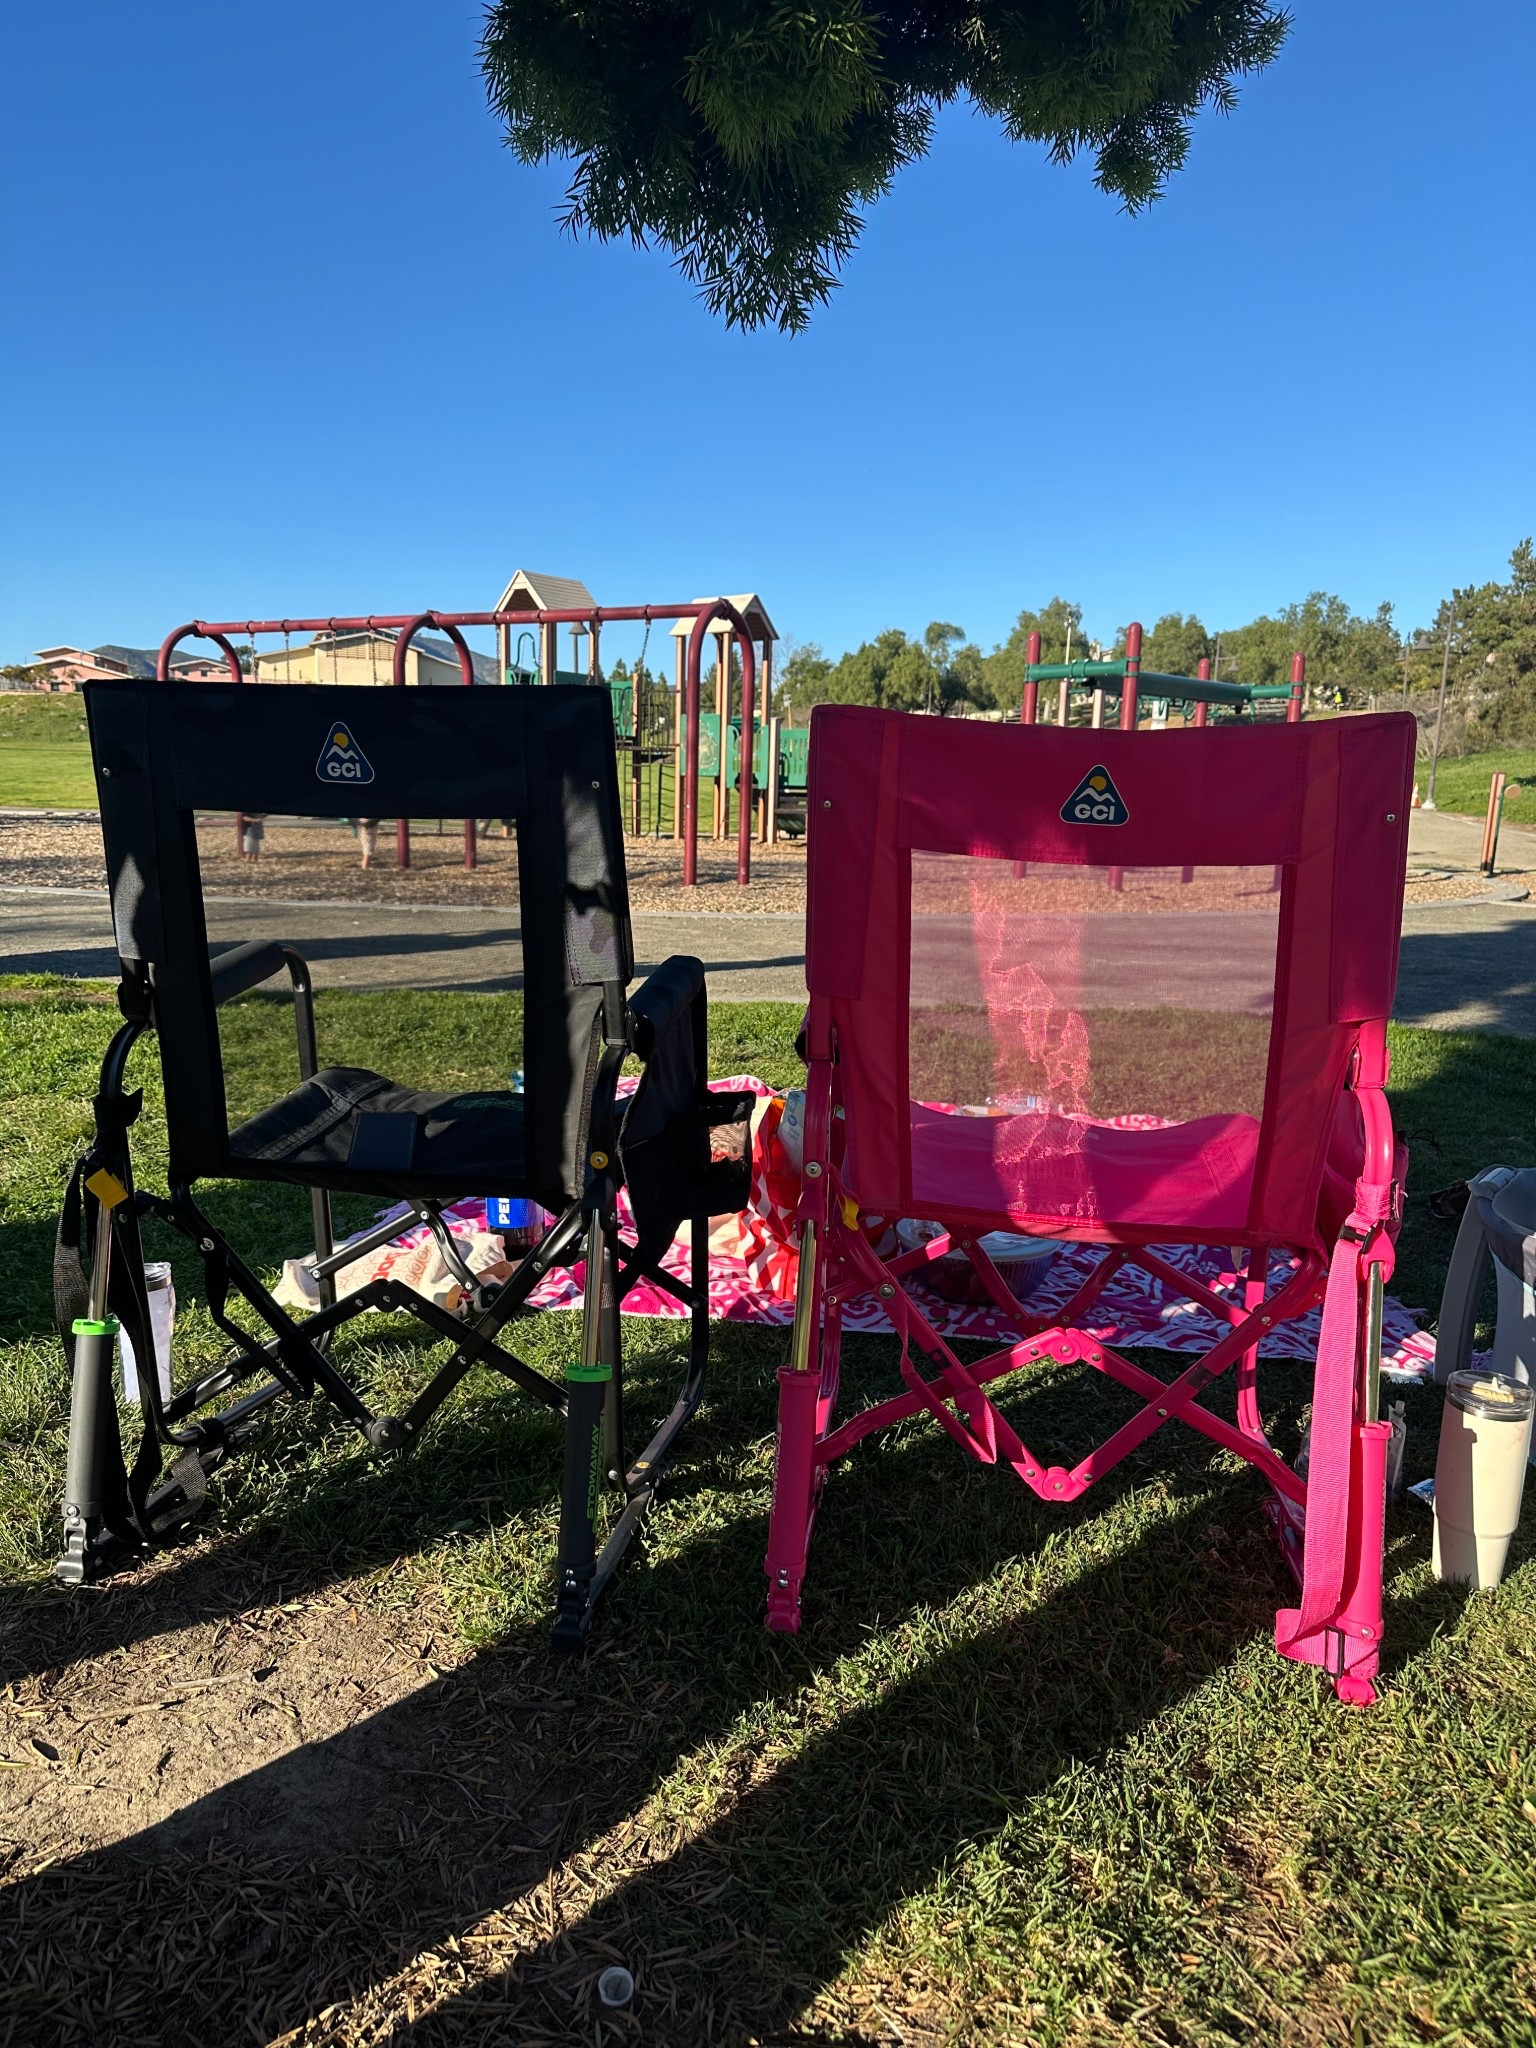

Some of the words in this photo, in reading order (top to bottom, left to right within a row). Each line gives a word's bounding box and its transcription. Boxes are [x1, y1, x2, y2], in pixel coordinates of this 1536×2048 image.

[327, 762, 362, 778] GCI
[1074, 803, 1116, 821] GCI
[587, 1423, 600, 1520] STOWAWAY
